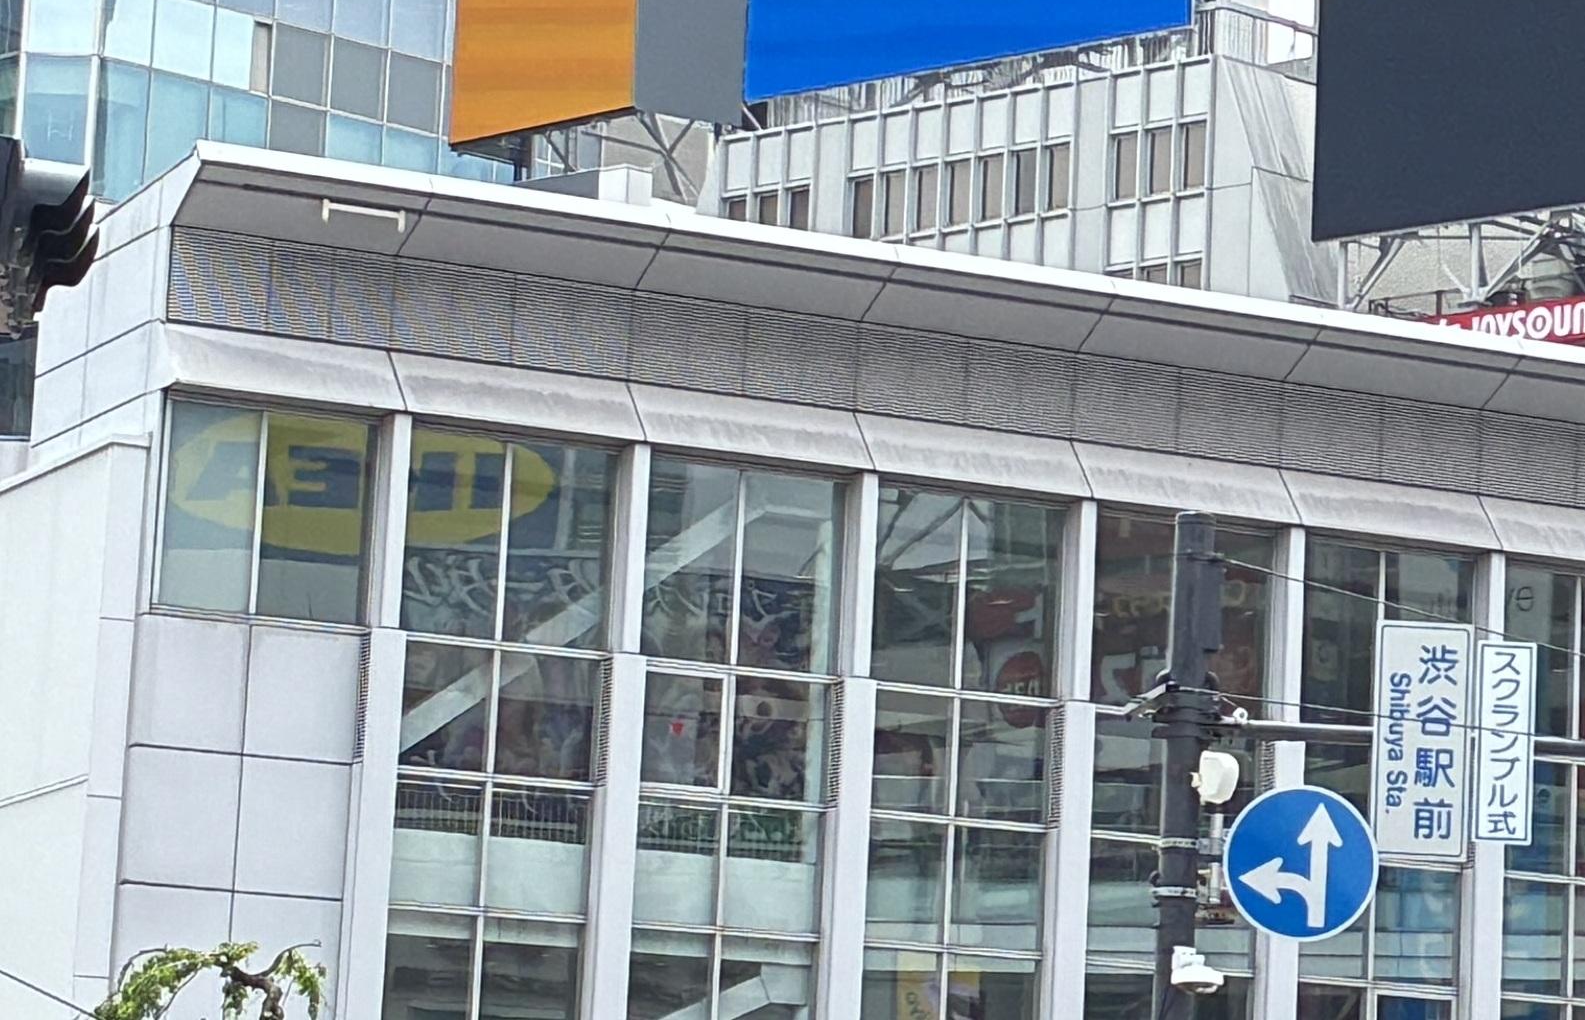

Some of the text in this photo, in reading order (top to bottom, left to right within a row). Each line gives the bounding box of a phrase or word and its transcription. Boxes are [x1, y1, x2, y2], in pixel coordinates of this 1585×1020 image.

[1383, 672, 1412, 815] Shibuya Sta.
[1413, 644, 1460, 840] 渋谷駅前
[1487, 650, 1522, 836] スクランブル式
